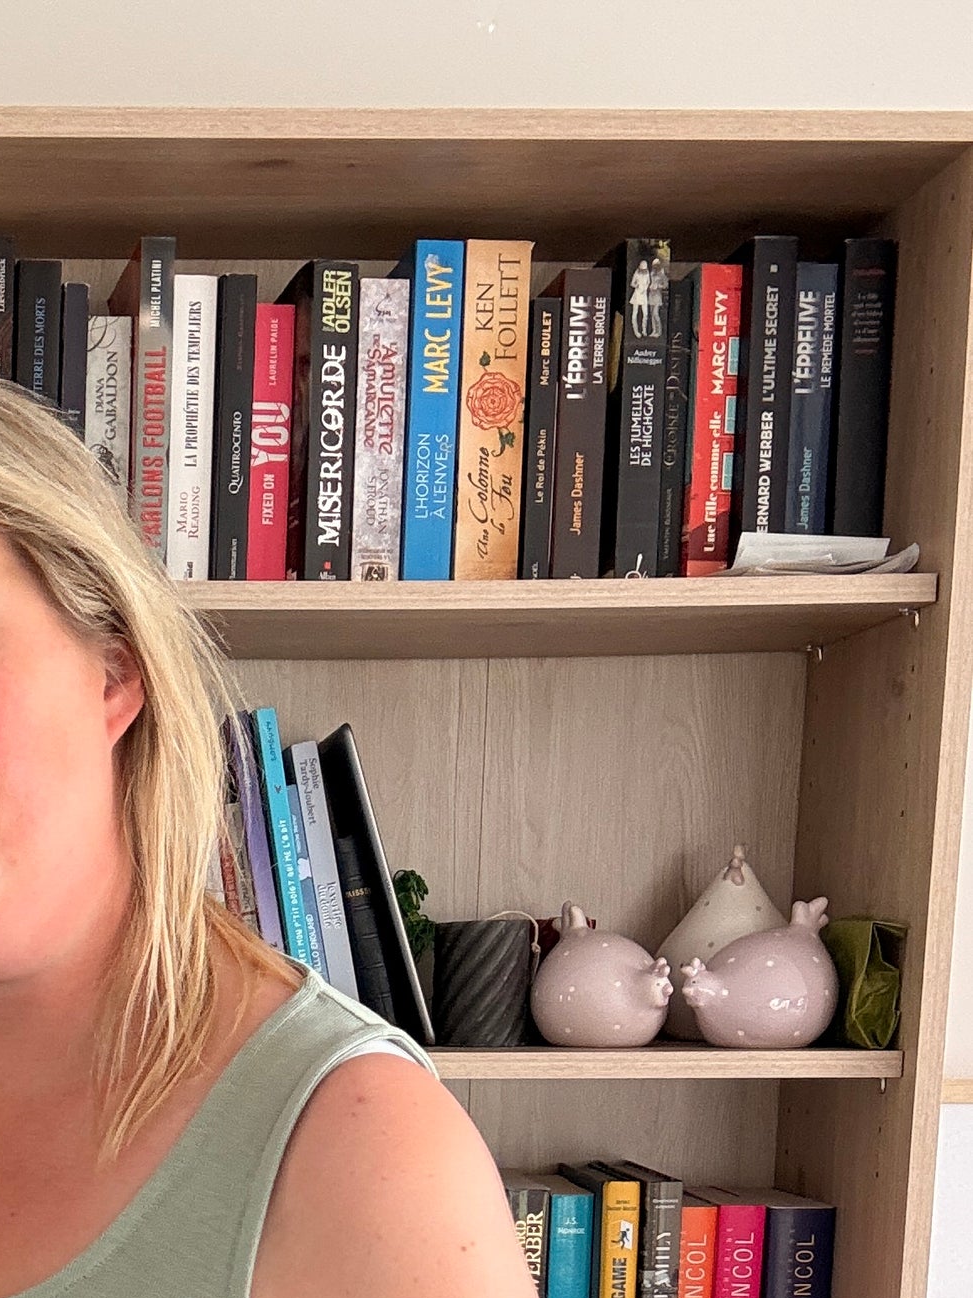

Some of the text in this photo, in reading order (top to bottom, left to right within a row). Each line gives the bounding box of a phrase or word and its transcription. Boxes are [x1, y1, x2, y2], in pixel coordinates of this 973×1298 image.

[323, 270, 336, 327] ADLER
[336, 270, 351, 333] OLSEN
[423, 262, 453, 393] MARC LEVY
[475, 282, 494, 330] KEN
[495, 253, 521, 361] FOLLETT
[540, 311, 552, 385] Marc BOULET
[562, 296, 591, 400] L'ÉPREUVE
[593, 297, 606, 384] LA TERRE BRÛLÉE
[712, 290, 728, 394] MARC LEVY
[763, 286, 778, 402] L'ULTIME SECRET
[792, 291, 819, 395] L'ÉPREUVE
[96, 378, 104, 413] DIANA
[106, 351, 117, 440] GABALDON
[183, 301, 201, 467] LA PROPHÉTIE DES TEMPLIERS
[630, 385, 643, 465] LES JUMELLES
[641, 384, 654, 466] DE HIGHGATE
[251, 402, 290, 525] FIXED ON YOU
[318, 344, 346, 546] MISERICORDE
[416, 434, 431, 518] L'HORIZON
[432, 434, 453, 519] À L'ENVERS
[535, 429, 546, 502] Le Roi de Pékin
[468, 447, 489, 559] Une Colonne
[489, 475, 514, 535] de Feu
[570, 452, 584, 535] James Dashner
[797, 447, 812, 530] James Dashner
[299, 759, 317, 825] Tardy-Joubert
[309, 758, 320, 789] Sophie
[654, 1231, 672, 1298] FAMILY
